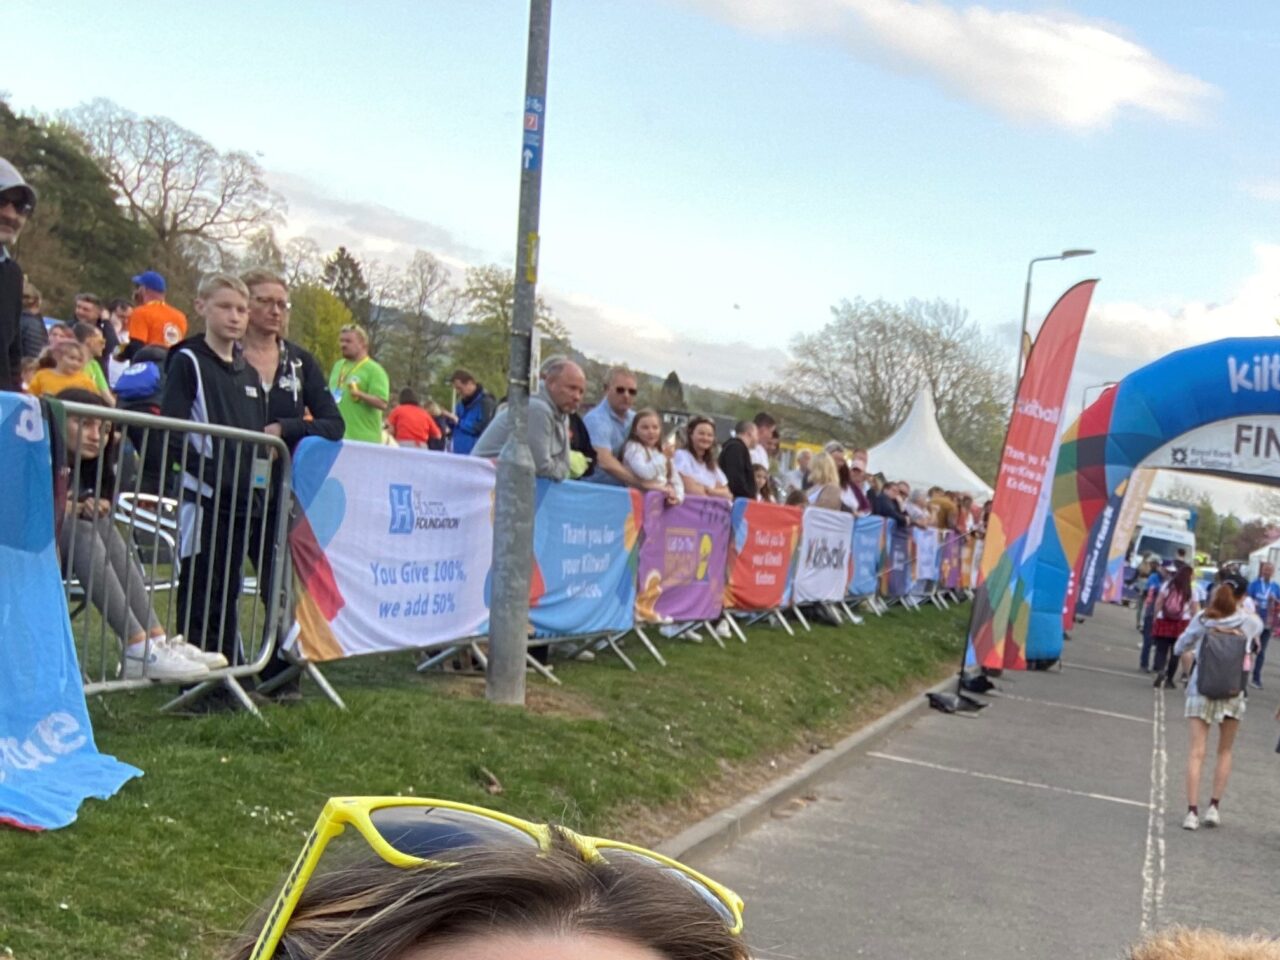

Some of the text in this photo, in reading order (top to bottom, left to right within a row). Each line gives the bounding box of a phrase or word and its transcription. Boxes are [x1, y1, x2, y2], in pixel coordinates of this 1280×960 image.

[370, 561, 398, 586] You
[400, 561, 429, 584] Give
[379, 592, 456, 618] we add 50%
